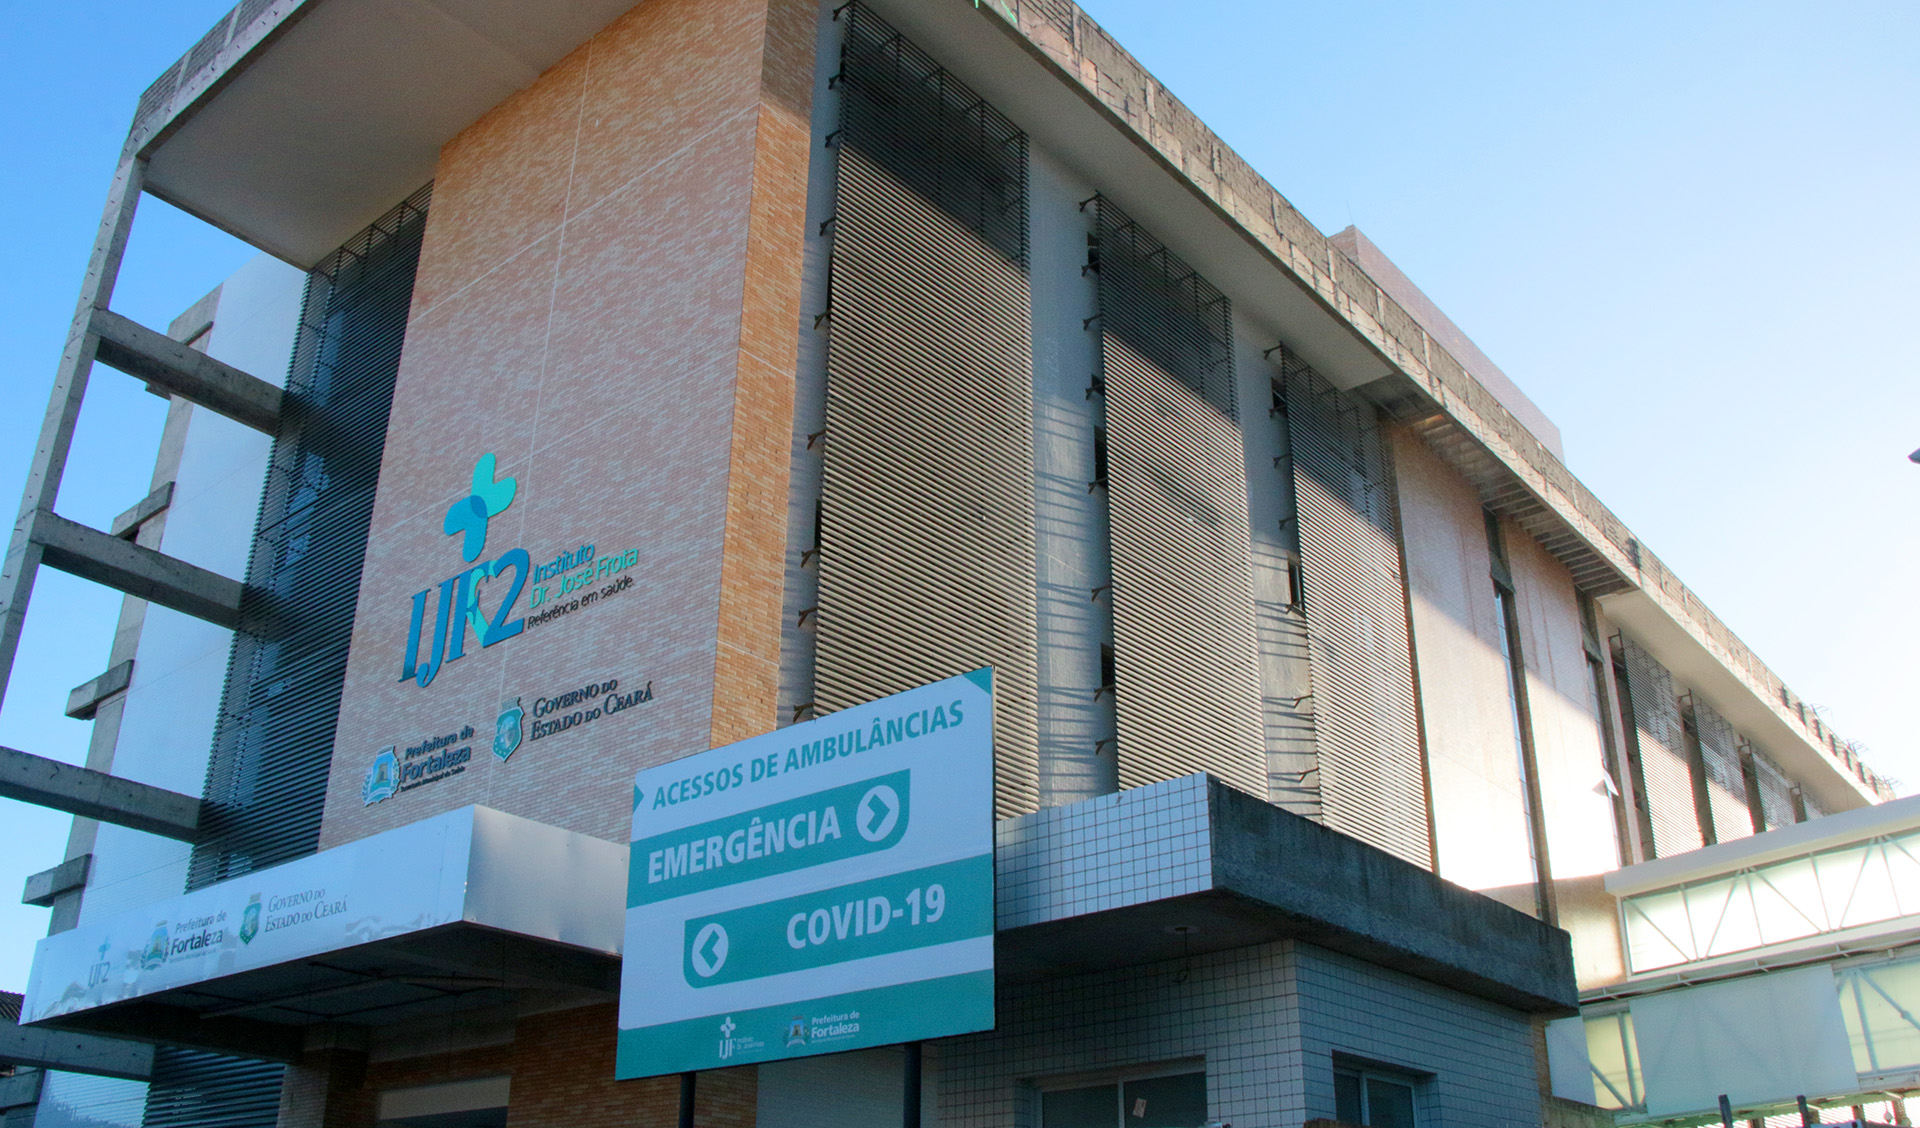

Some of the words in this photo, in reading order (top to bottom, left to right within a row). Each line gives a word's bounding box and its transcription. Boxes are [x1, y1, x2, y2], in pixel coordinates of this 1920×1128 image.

[529, 586, 551, 609] Dr.
[554, 561, 594, 598] José
[595, 548, 639, 580] Frota
[533, 544, 595, 585] Instituto
[527, 598, 579, 629] Referência
[581, 591, 598, 607] em
[530, 711, 583, 741] ESTADO
[584, 708, 601, 723] DO
[603, 680, 653, 715] CEARÁ
[533, 683, 600, 718] GOVERNO
[601, 679, 618, 694] DO
[405, 733, 457, 760] Prefeitura
[460, 725, 474, 740] de
[652, 763, 744, 810] ACESSOS
[750, 753, 779, 783] DE
[783, 700, 964, 773] AMBULÂNCIAS
[401, 746, 471, 783] Fortaleza
[648, 805, 842, 884] EMERGÊNCIA
[264, 912, 300, 933] ESTADO
[314, 894, 347, 919] CEARÁ
[268, 889, 312, 912] GOVERNO
[786, 883, 946, 949] COVID-19
[175, 914, 214, 934] Prefeitura
[216, 909, 227, 922] de
[170, 929, 223, 955] Fortaleza
[811, 1014, 849, 1025] Prefeitura
[850, 1010, 860, 1019] de
[811, 1022, 860, 1038] Fortaleza
[719, 1038, 737, 1060] IJF
